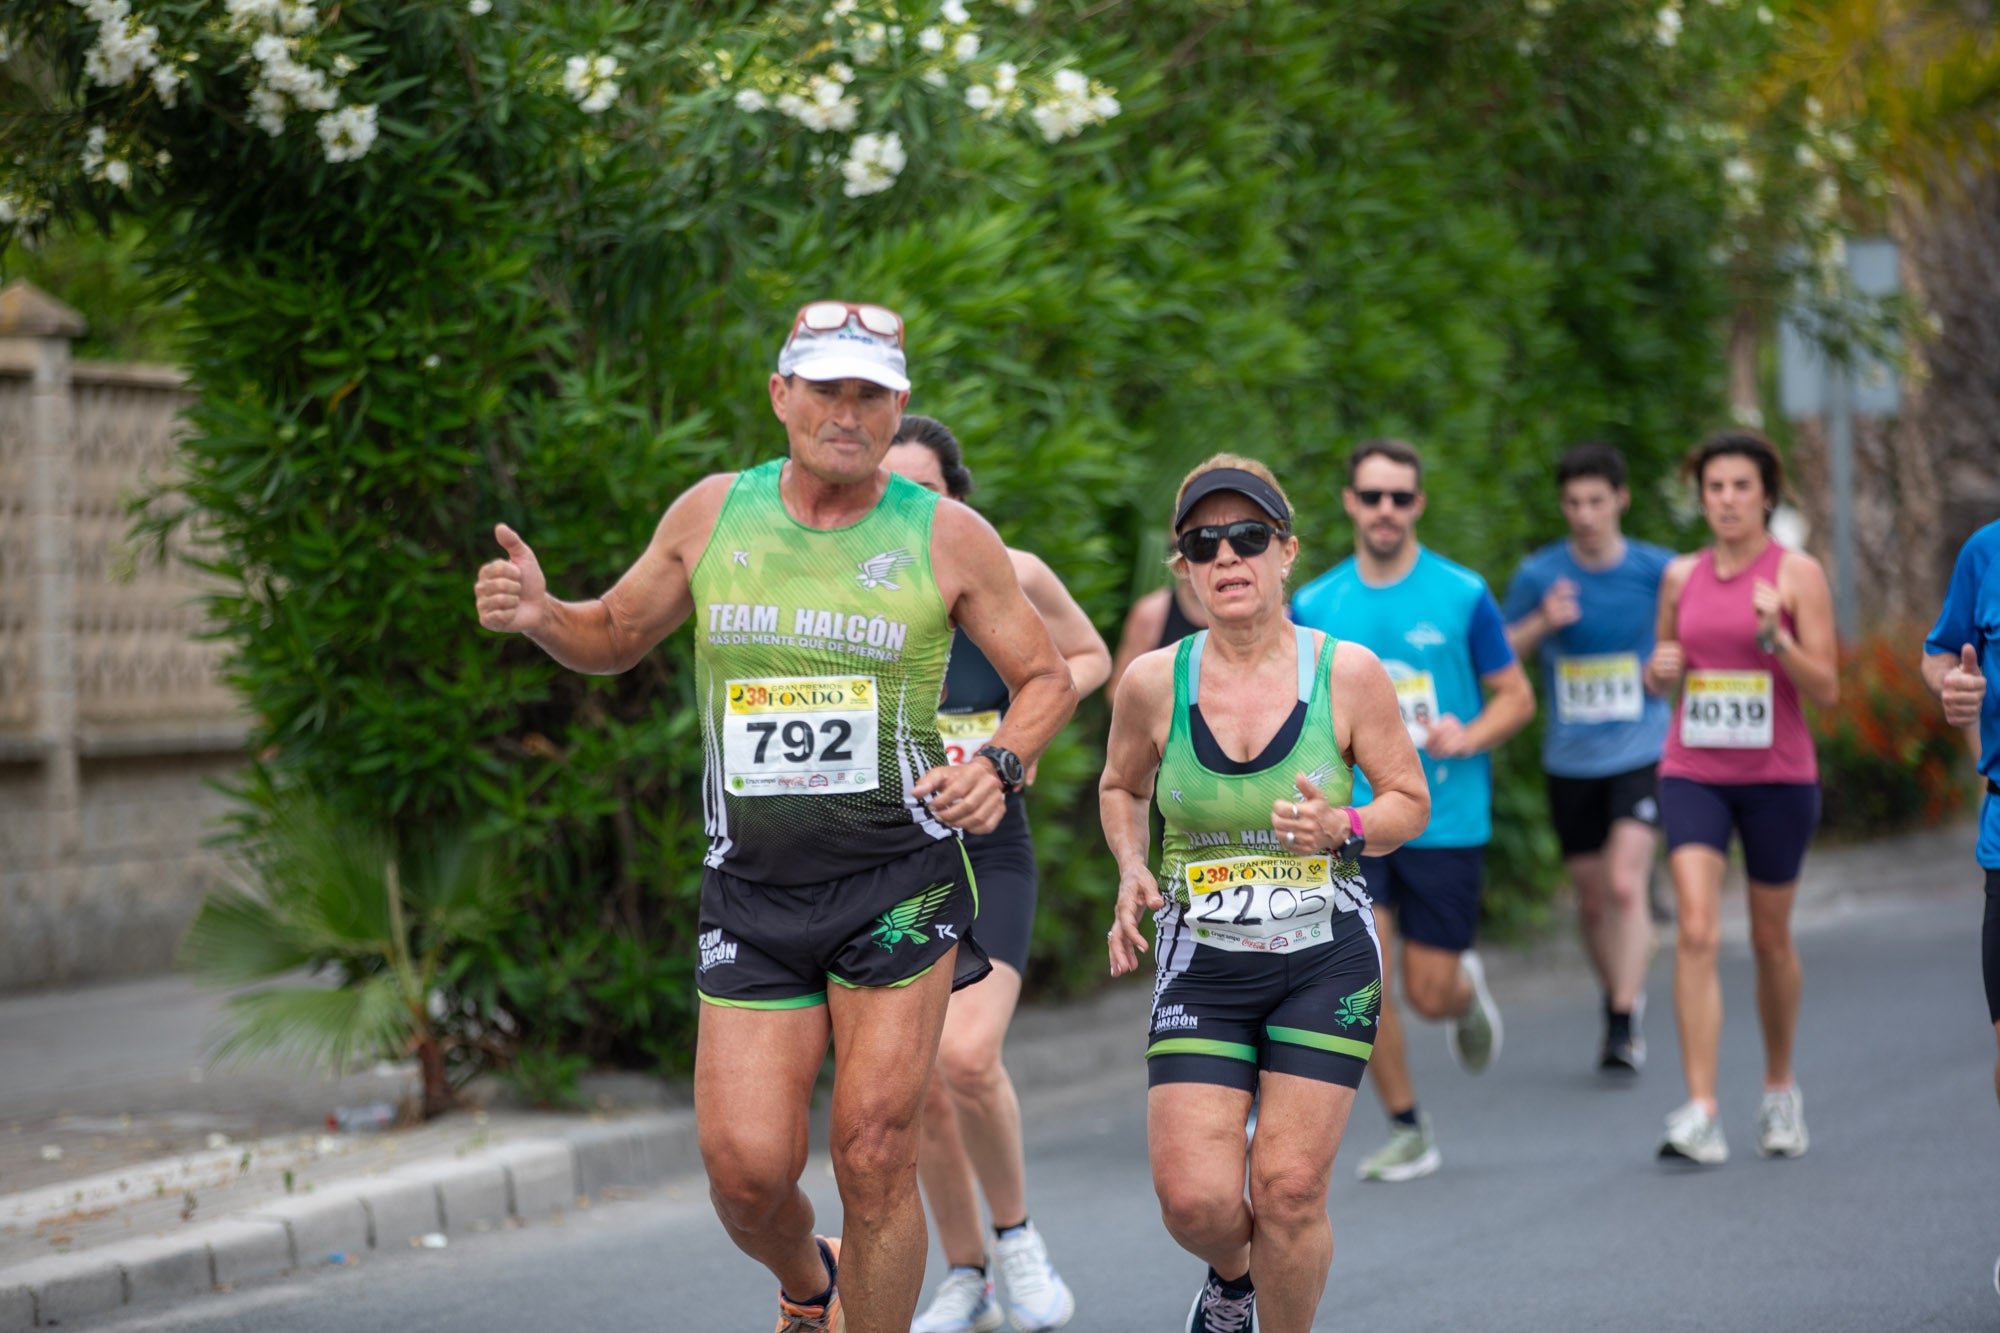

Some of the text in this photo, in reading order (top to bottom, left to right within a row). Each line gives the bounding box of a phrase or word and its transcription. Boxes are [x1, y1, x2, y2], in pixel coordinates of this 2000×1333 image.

[708, 604, 907, 651] TEAM HALCÓN
[732, 634, 748, 645] DE
[752, 634, 795, 647] MENTE
[798, 639, 824, 650] QUE
[828, 642, 844, 653] DE
[847, 645, 900, 663] PIERNAS
[746, 687, 843, 706] 38 FONDO
[771, 684, 797, 692] GRAN
[800, 683, 836, 691] PREMIO
[746, 719, 852, 764] 792
[1241, 830, 1280, 845] HAL
[1233, 861, 1258, 870] GRAN
[1261, 859, 1296, 867] PREMIO
[1206, 866, 1302, 884] 38 FONDO
[1196, 885, 1326, 926] 2205
[1157, 1004, 1184, 1020] TEAM
